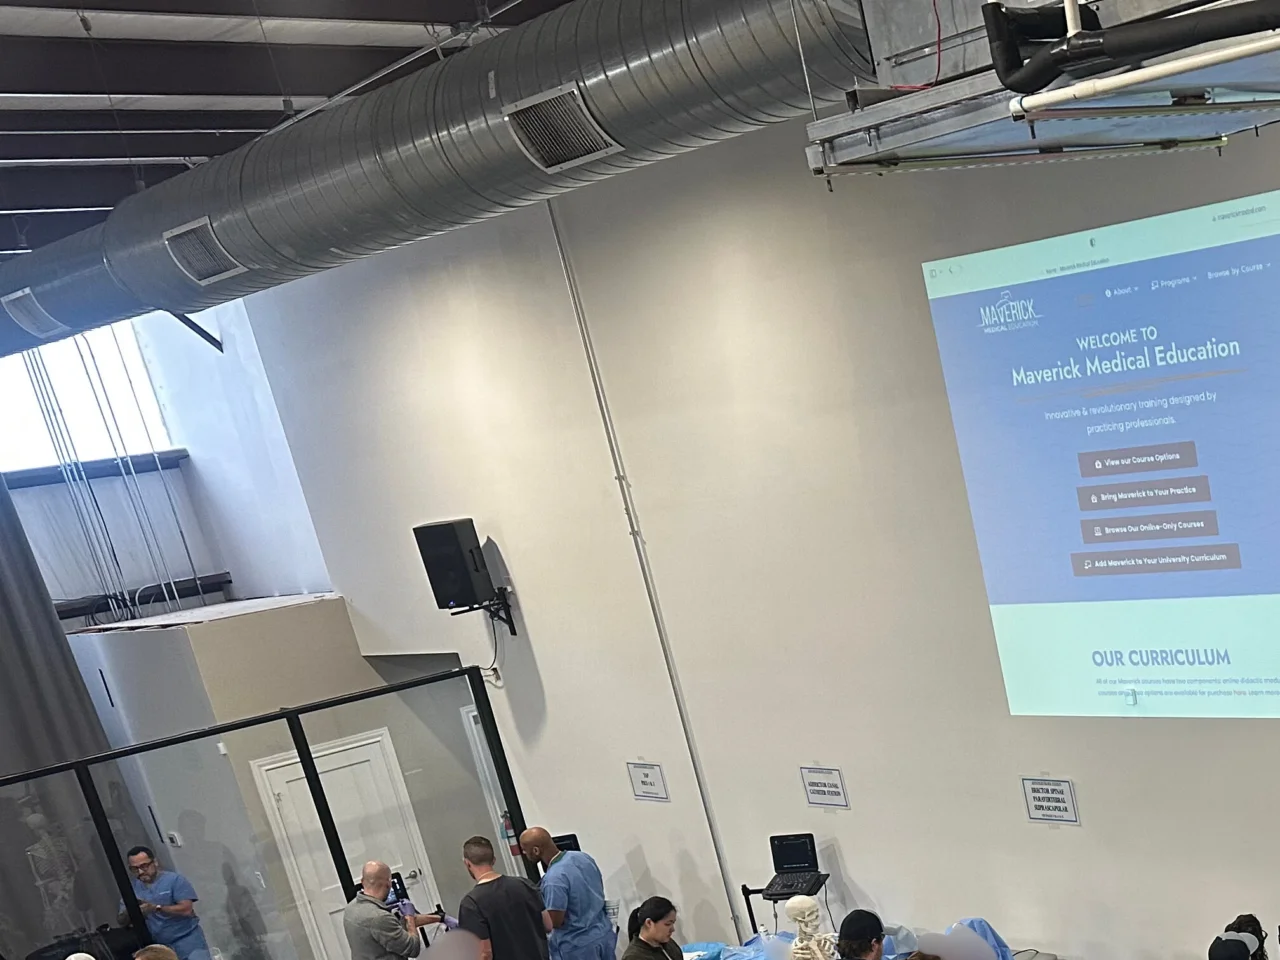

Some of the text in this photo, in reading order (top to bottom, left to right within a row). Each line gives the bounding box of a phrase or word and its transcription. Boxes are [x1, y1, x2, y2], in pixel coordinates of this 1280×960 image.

[1207, 262, 1264, 279] Browse by Course
[1113, 285, 1132, 296] About
[1160, 276, 1190, 289] Programs
[980, 298, 1037, 326] MAVERICK
[984, 324, 1008, 333] MEDICAL
[1076, 326, 1158, 351] WELCOME TO
[1012, 338, 1241, 386] Maverick Medical Education
[1044, 391, 1217, 420] Innovative & revolutionary training designed by
[1086, 415, 1177, 436] practicing professionals.
[1104, 452, 1180, 467] View our Course Options
[1100, 493, 1118, 502] Bring
[1118, 490, 1146, 499] Maverick
[1154, 488, 1169, 496] Your
[1170, 486, 1197, 494] Practice
[1104, 521, 1205, 534] Browse Our Online-Only Courses
[1094, 553, 1227, 567] Add Maverick to Your University Curriculum
[1092, 648, 1232, 667] OUR CURRICULUM
